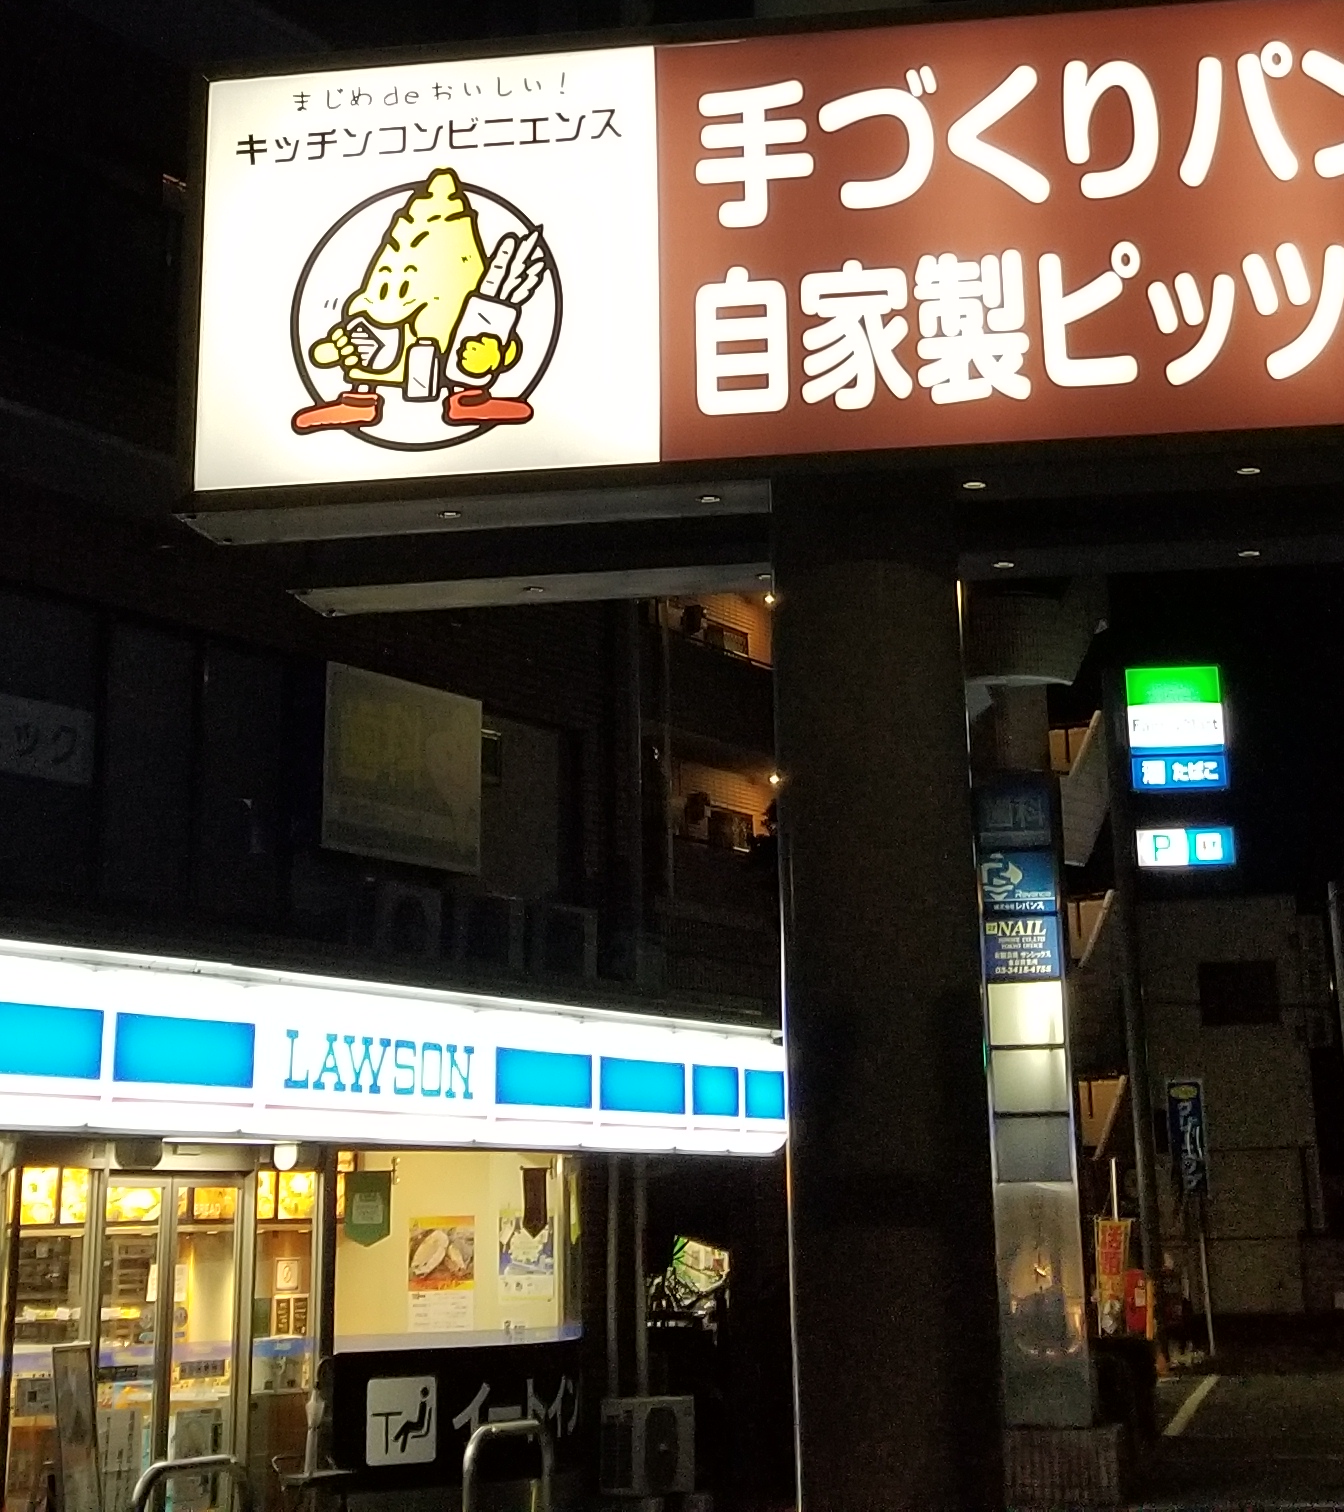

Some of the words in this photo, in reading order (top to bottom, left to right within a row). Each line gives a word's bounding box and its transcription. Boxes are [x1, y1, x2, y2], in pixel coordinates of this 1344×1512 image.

[236, 108, 622, 166] キッチンコンビニエンス
[1152, 834, 1171, 862] P
[998, 920, 1046, 936] NAIL
[283, 1029, 475, 1099] LAWSON
